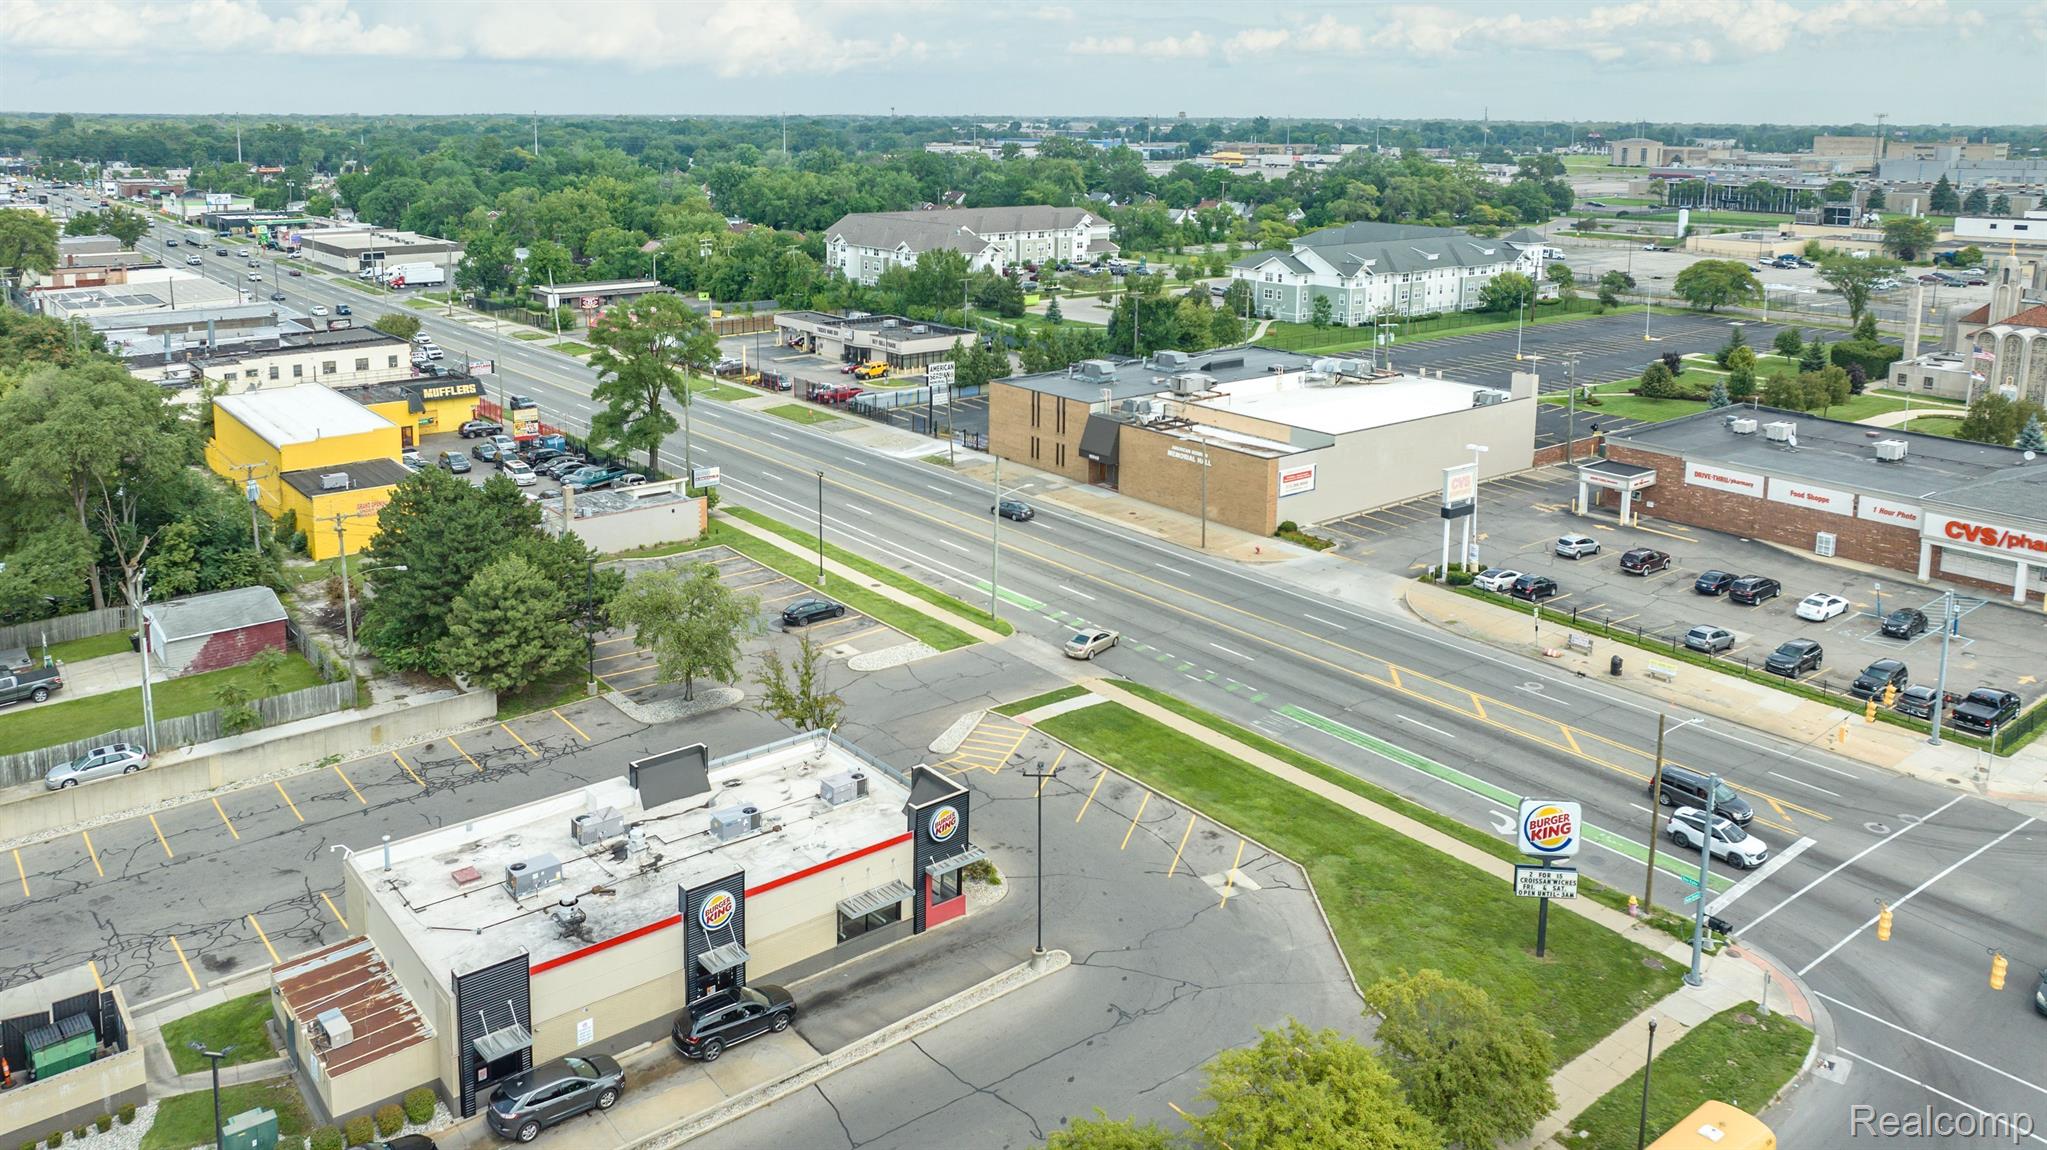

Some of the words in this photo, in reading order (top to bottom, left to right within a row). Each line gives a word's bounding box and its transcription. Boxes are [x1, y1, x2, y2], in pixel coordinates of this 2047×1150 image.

[930, 364, 954, 372] AMERICAN
[423, 383, 477, 399] MUFFLERS
[1167, 449, 1196, 463] MEMORIAL
[1451, 475, 1470, 490] CVS
[1694, 471, 1754, 488] DRIVE-THRU/pharmacy
[1790, 489, 1805, 499] Food
[1807, 493, 1830, 504] Shoppe
[1878, 507, 1895, 517] Hour
[1896, 511, 1917, 521] Photo
[1945, 521, 2047, 552] CVS/pha
[935, 811, 955, 828] BURGER
[935, 817, 956, 836] KING
[1530, 813, 1570, 830] BURGER
[1530, 823, 1571, 842] KING
[705, 896, 731, 917] BURGER
[706, 902, 732, 925] KING
